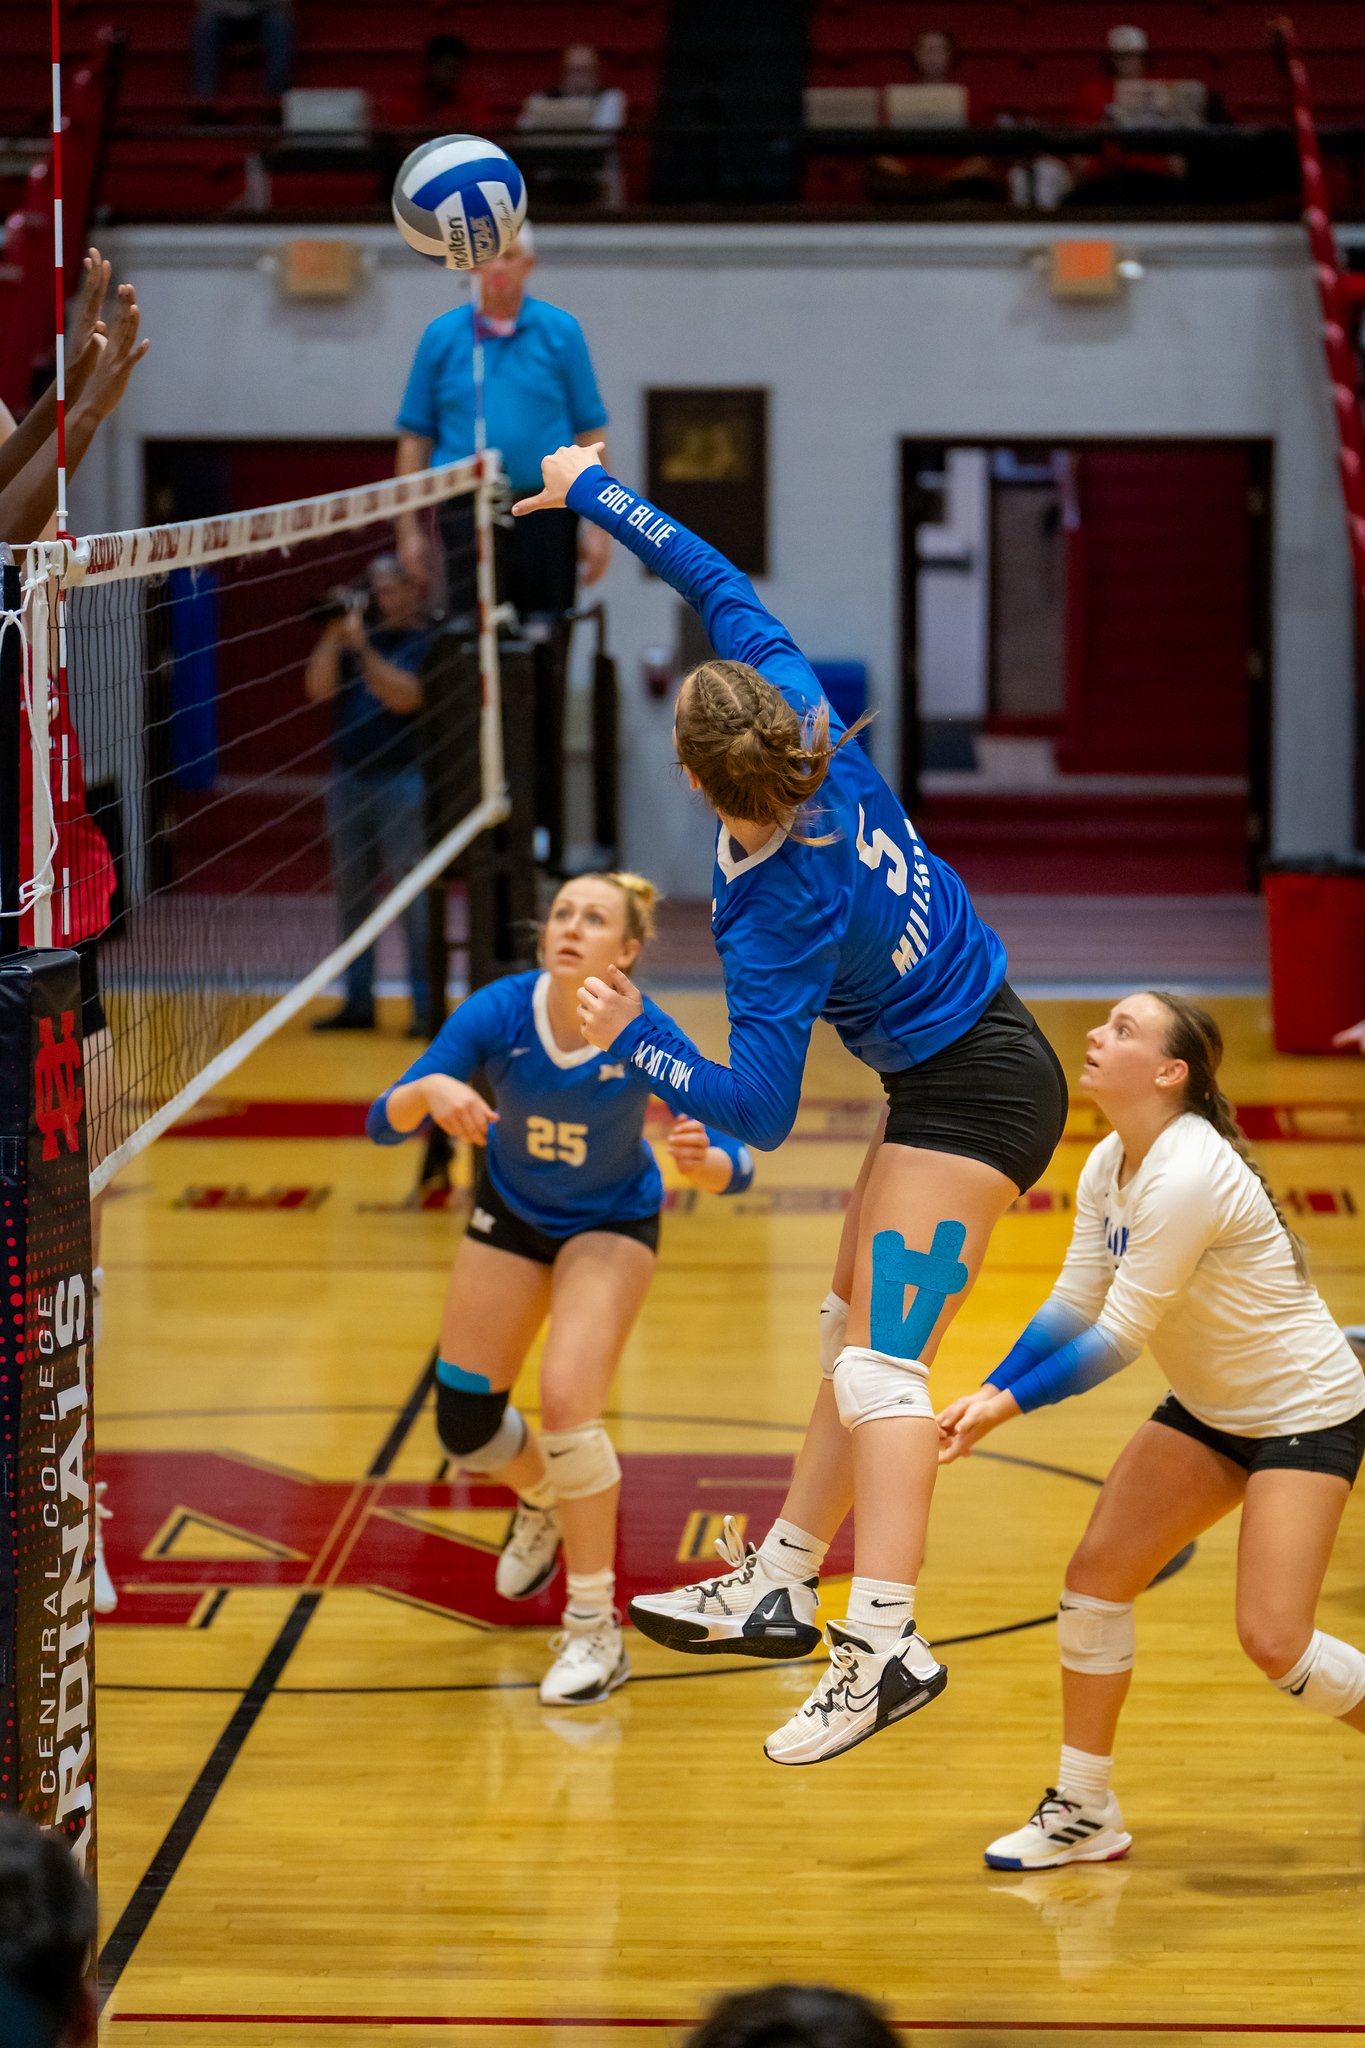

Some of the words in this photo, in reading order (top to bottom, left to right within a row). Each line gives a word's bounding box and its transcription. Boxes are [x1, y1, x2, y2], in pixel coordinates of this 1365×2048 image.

[448, 216, 470, 269] molten
[597, 483, 635, 515] BIG
[626, 504, 677, 549] BLUE
[856, 802, 908, 896] 5
[526, 1115, 589, 1168] 25
[37, 1294, 60, 1528] COLLEGE
[54, 1273, 93, 1876] RDINALS
[38, 1556, 61, 1794] CENTRAL
